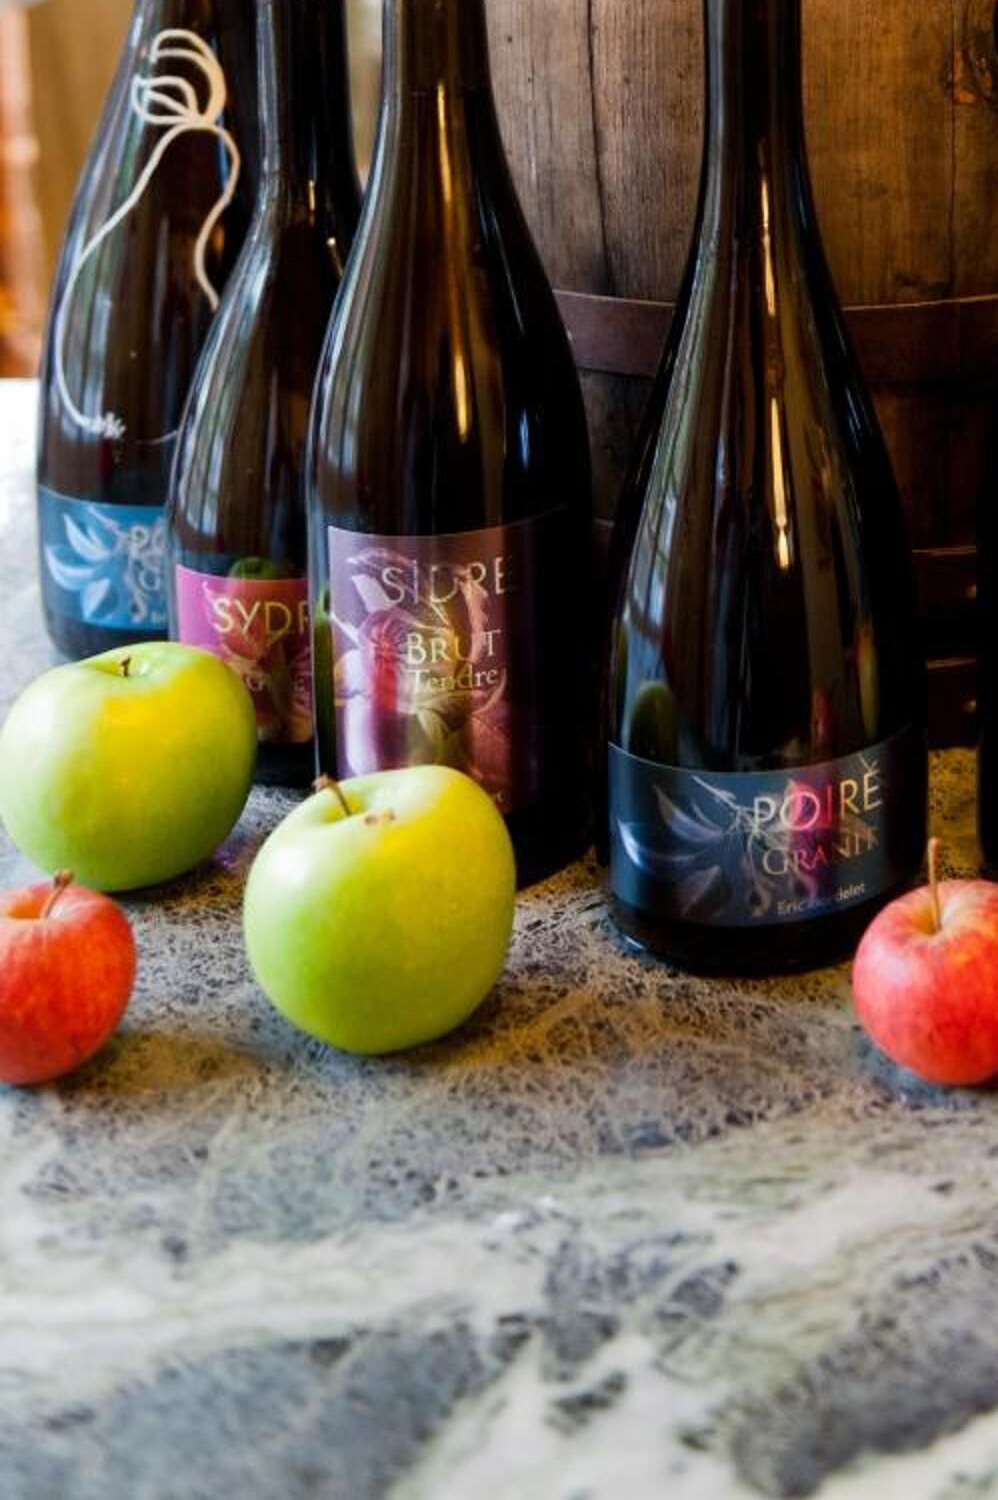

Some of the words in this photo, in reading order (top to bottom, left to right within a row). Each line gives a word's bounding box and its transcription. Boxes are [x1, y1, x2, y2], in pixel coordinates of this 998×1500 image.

[381, 556, 506, 605] SIDRE
[405, 629, 501, 666] BRUT
[407, 664, 498, 693] Tendre
[753, 758, 883, 832] POIRÉ
